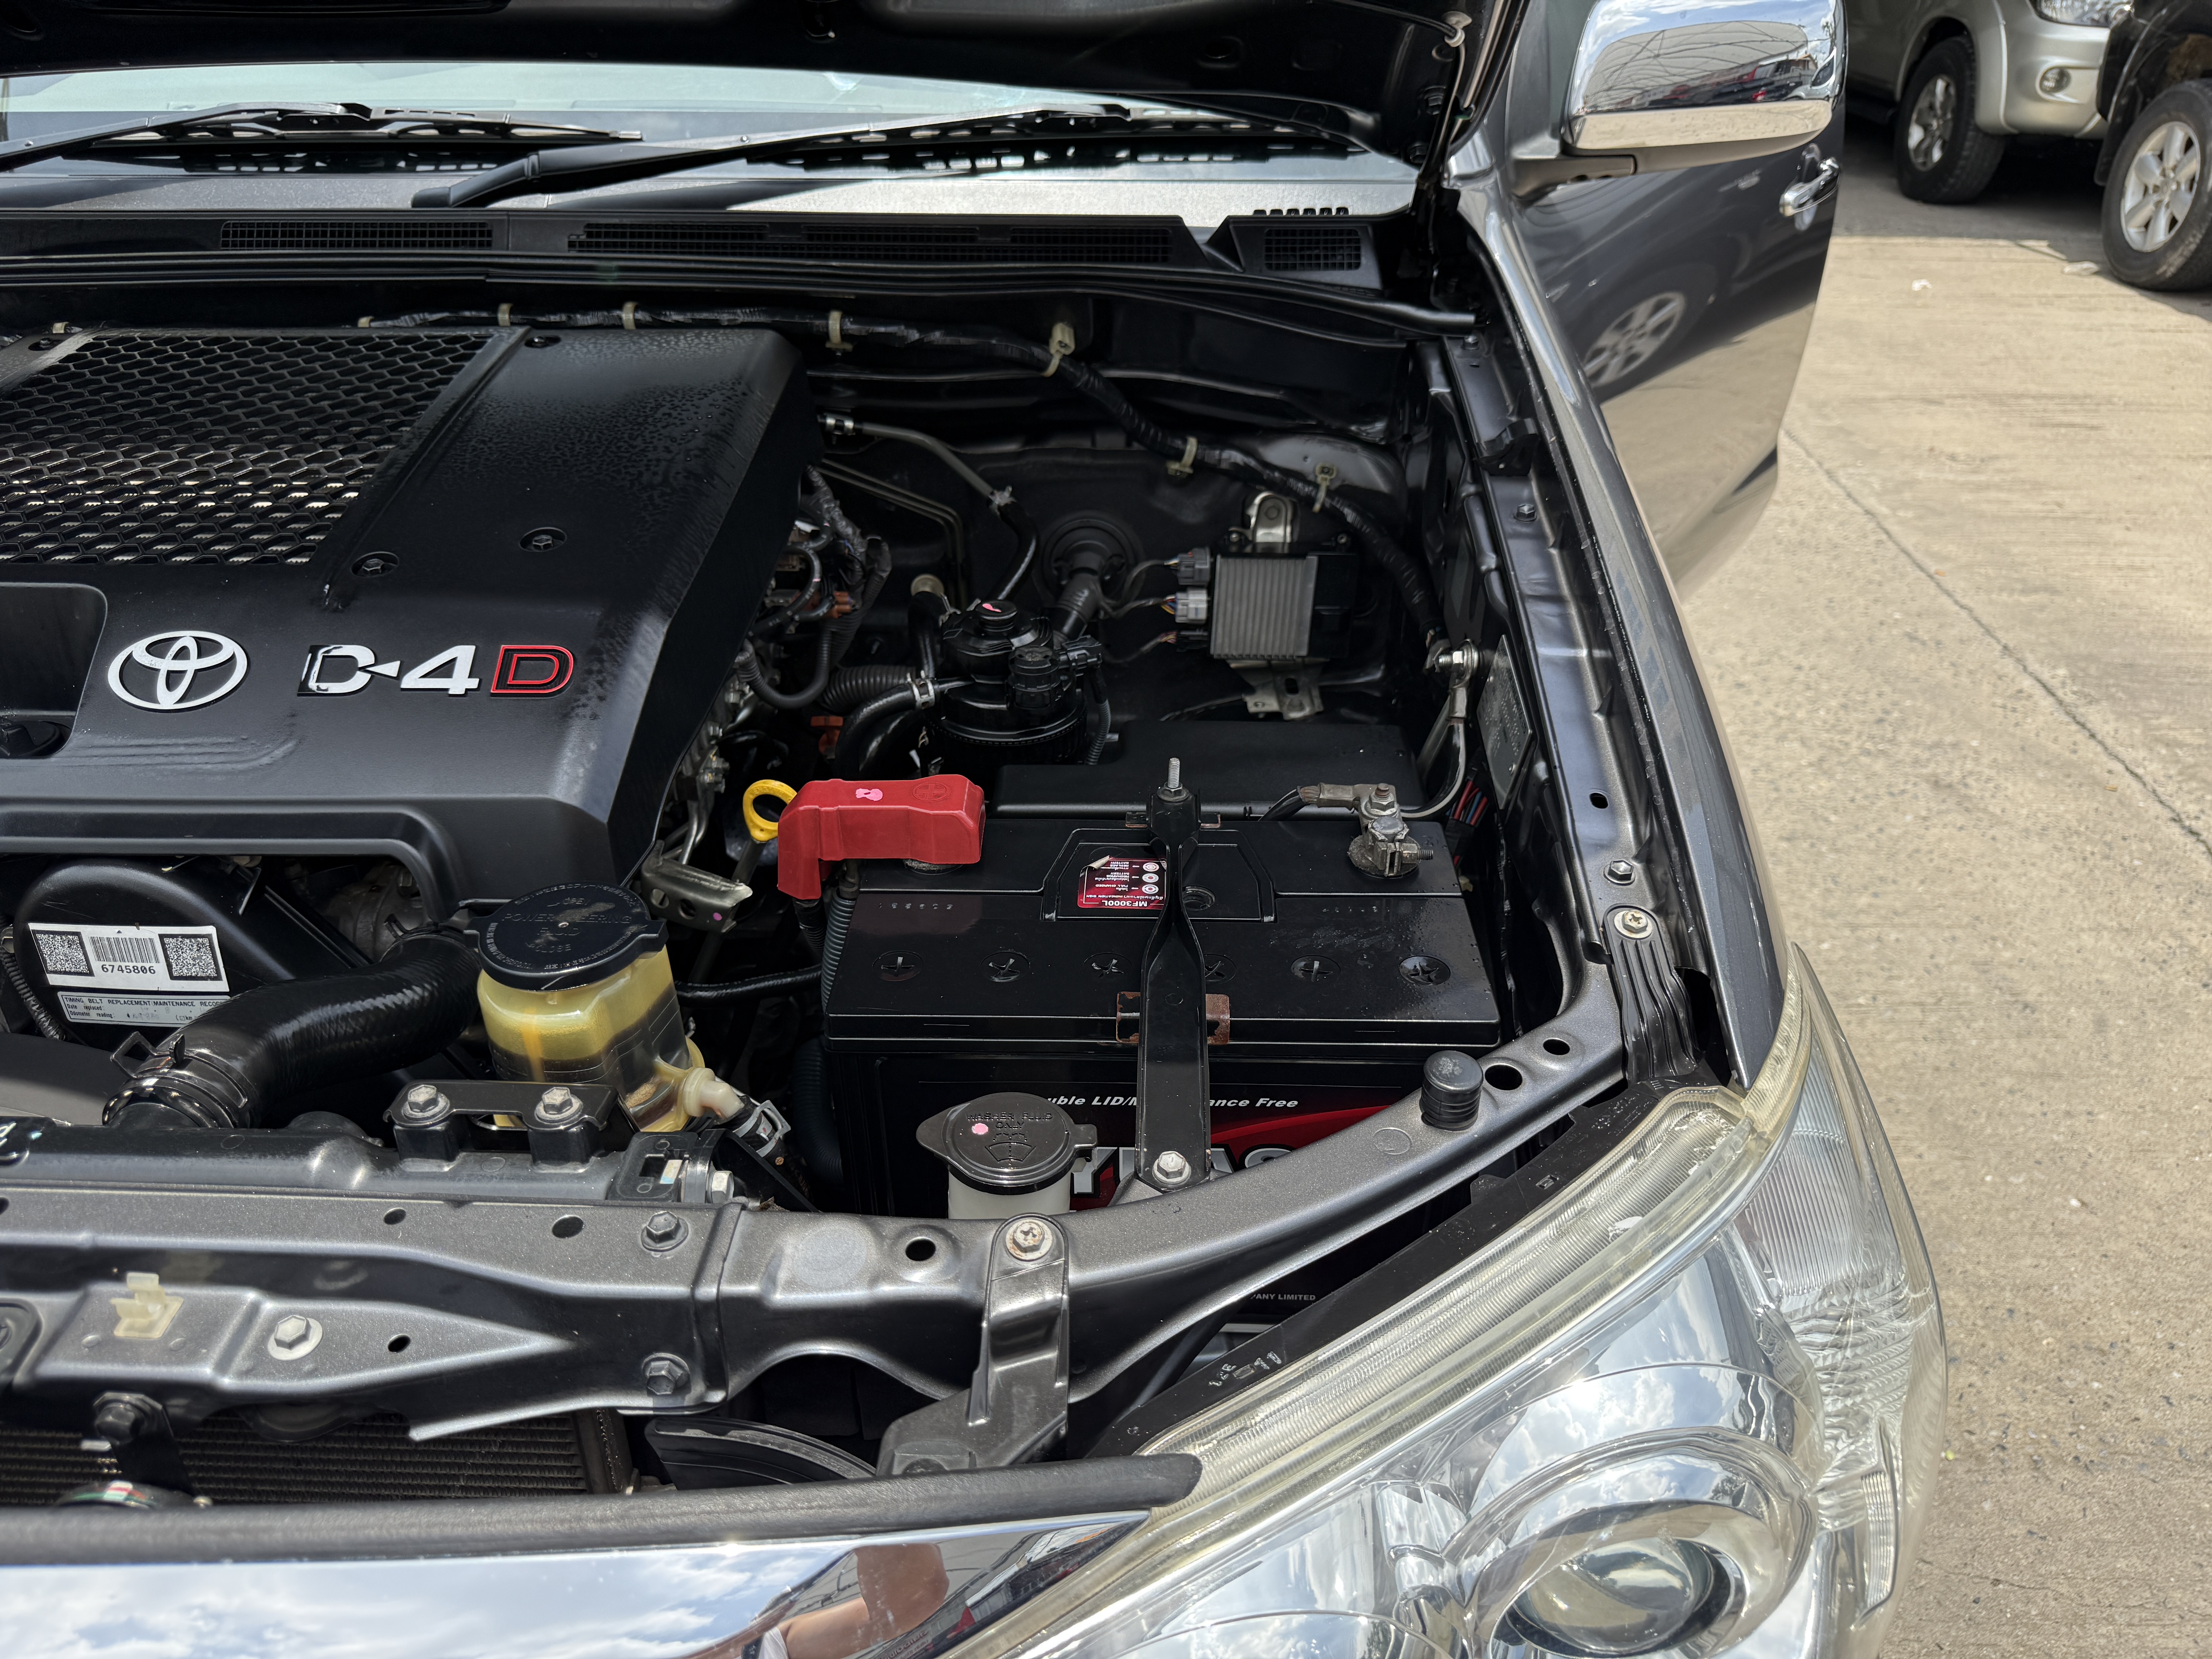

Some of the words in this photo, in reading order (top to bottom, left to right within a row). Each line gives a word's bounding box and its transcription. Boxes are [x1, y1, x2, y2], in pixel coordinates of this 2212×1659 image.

[101, 964, 156, 974] 6745806
[1255, 1098, 1298, 1107] Free
[966, 1112, 1015, 1121] WASHER
[1021, 1112, 1053, 1121] FLUID
[995, 1121, 1025, 1130] ONLY
